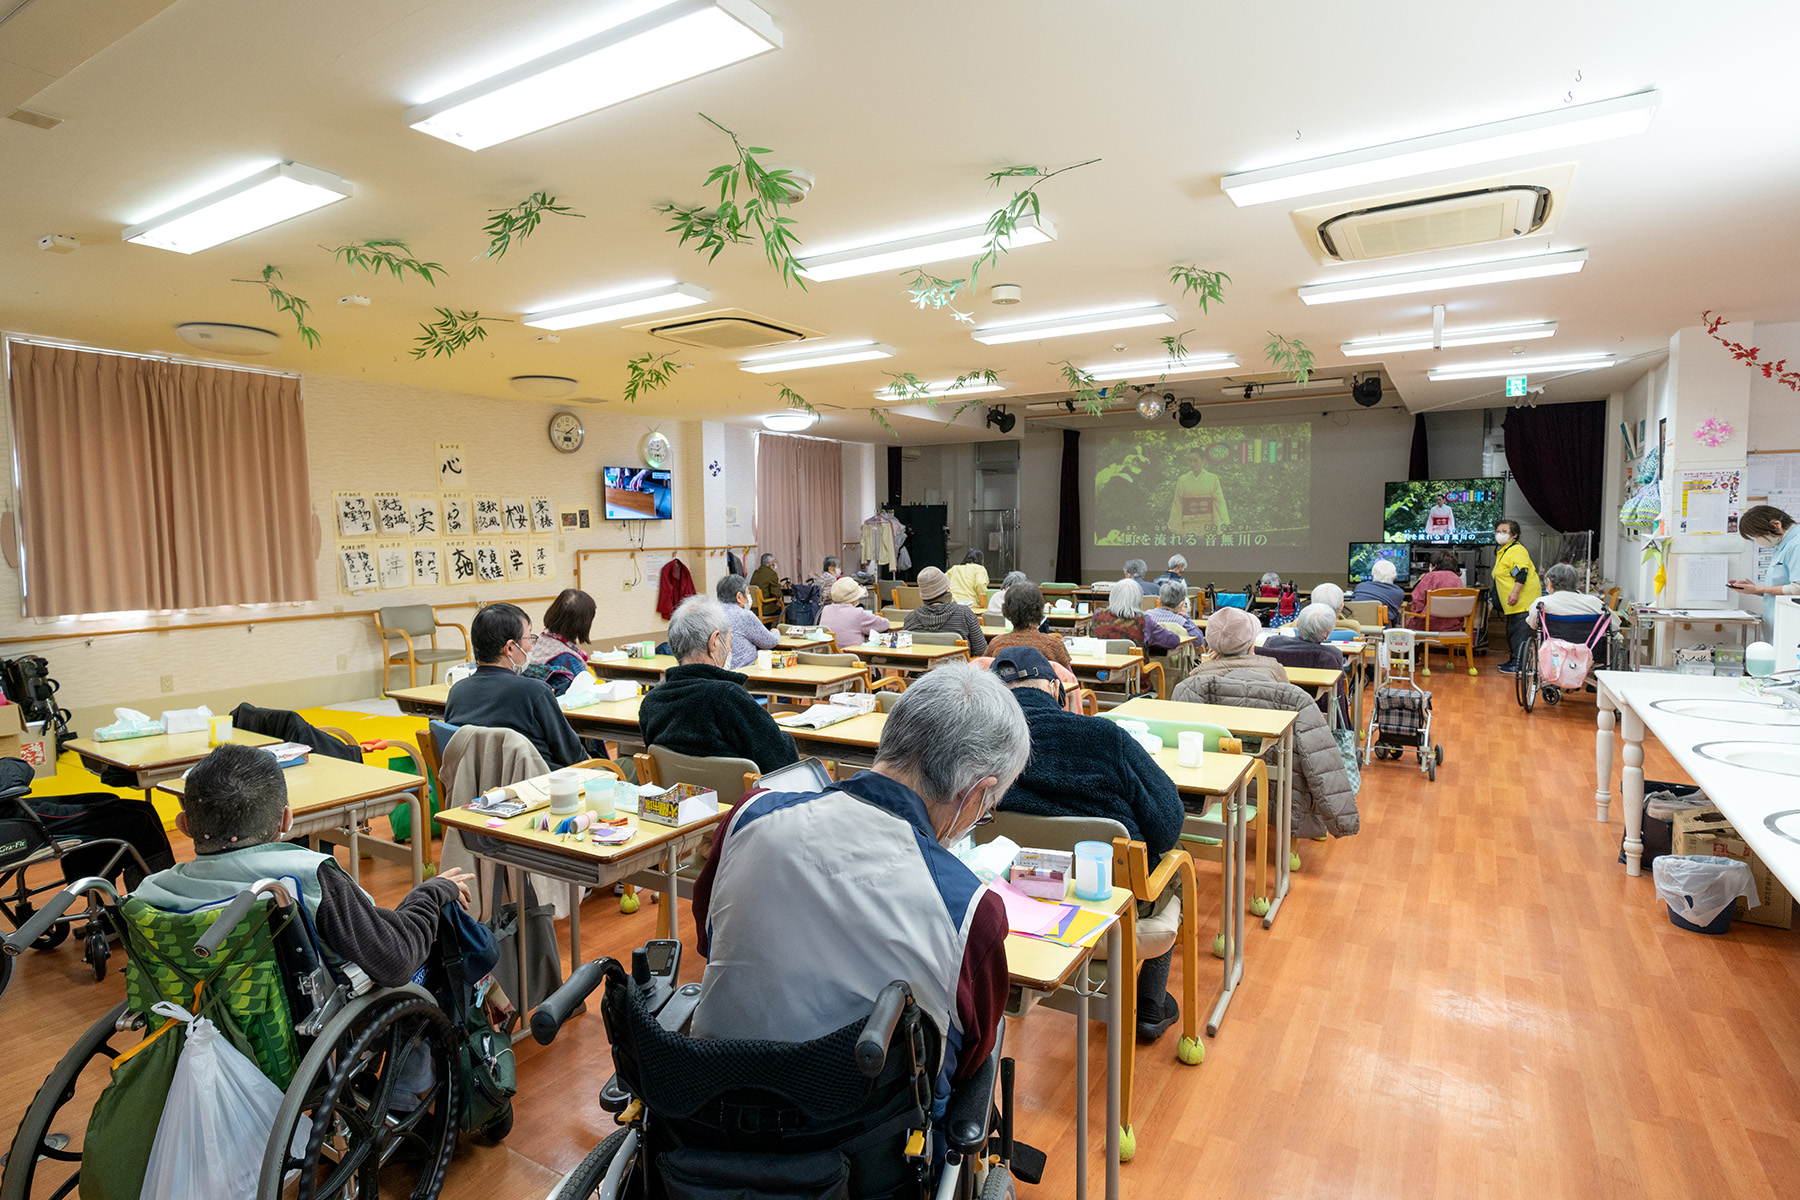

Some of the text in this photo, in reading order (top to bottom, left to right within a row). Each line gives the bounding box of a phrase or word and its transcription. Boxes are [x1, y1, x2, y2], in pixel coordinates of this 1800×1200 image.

[442, 457, 462, 474] 心
[415, 507, 435, 532] 実
[505, 504, 528, 529] 桜
[1125, 533, 1268, 547] 町を流れる 音無川の
[452, 548, 474, 579] 大地
[510, 549, 523, 571] 学
